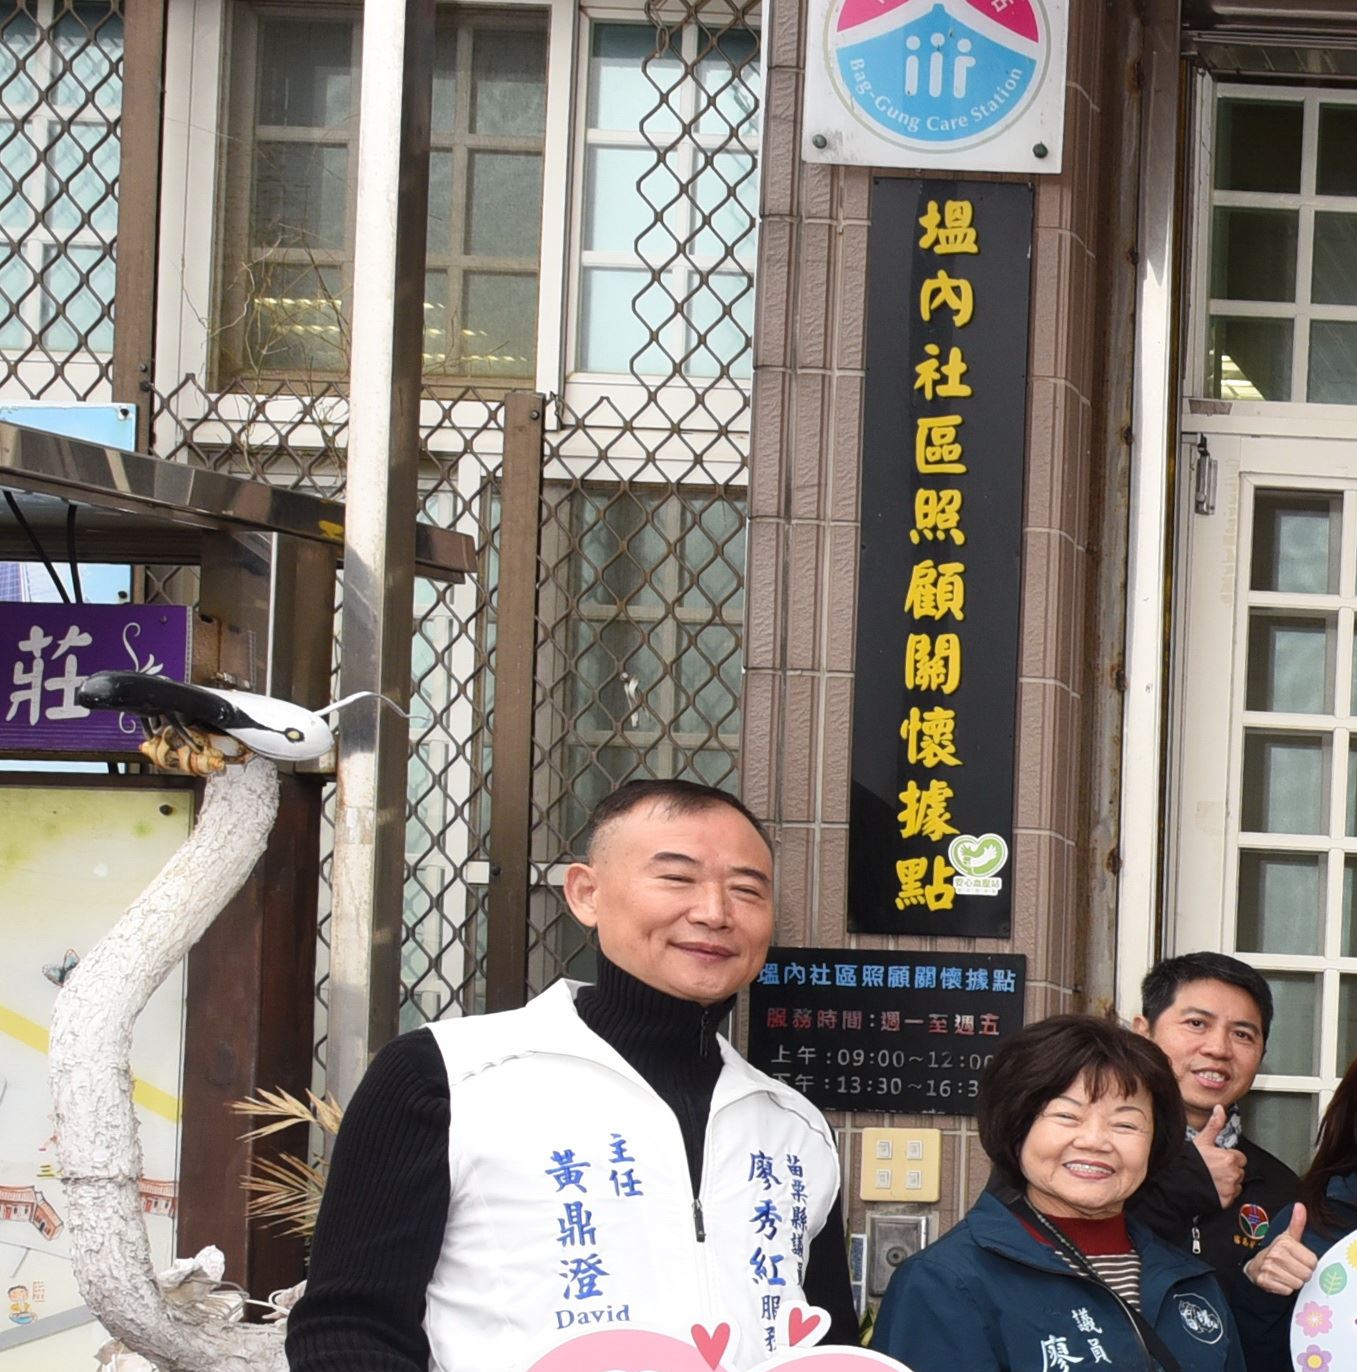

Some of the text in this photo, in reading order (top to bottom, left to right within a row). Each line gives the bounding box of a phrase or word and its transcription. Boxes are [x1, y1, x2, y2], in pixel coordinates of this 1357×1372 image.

[849, 57, 1023, 133] Bag-Gung Care Station
[5, 625, 93, 726] 莊
[608, 1133, 645, 1198] 主任
[545, 1149, 611, 1301] 黃鼎澄
[555, 1304, 632, 1331] David
[1071, 1307, 1112, 1366] 議員
